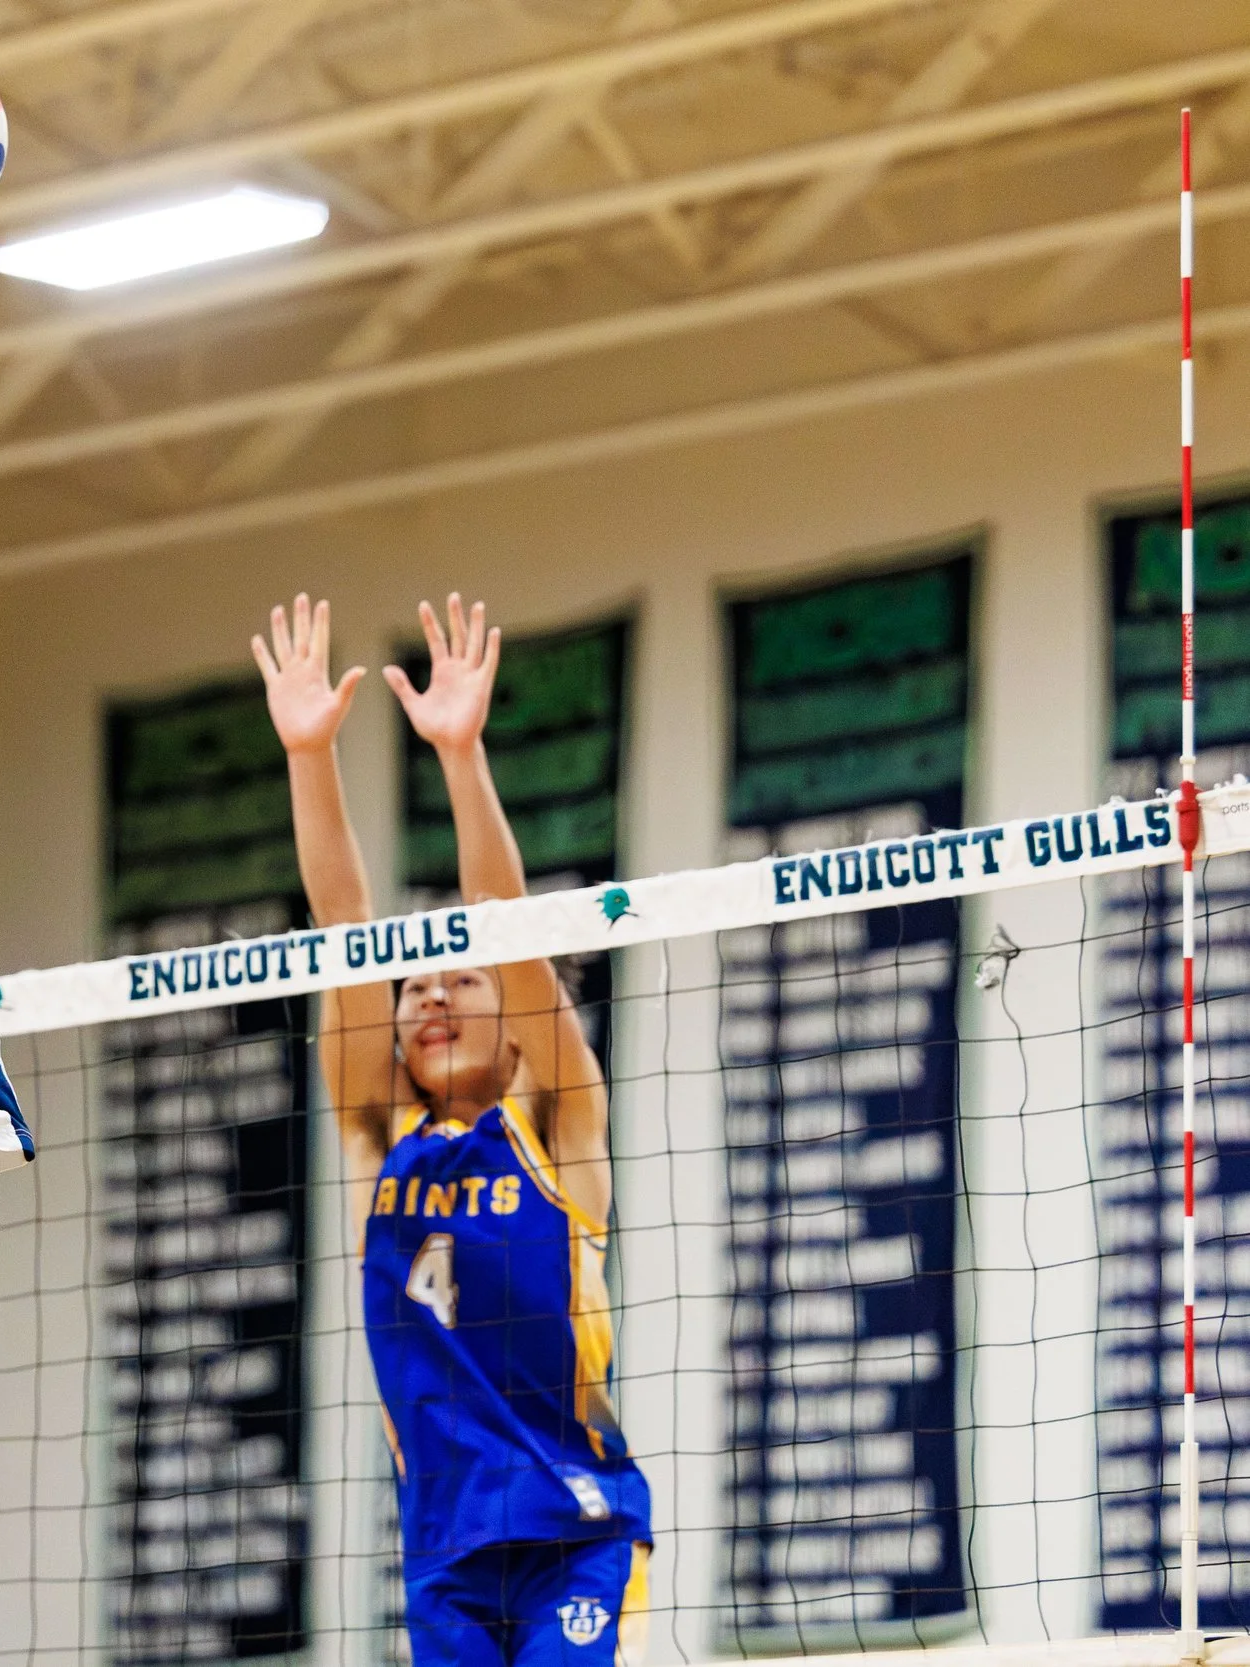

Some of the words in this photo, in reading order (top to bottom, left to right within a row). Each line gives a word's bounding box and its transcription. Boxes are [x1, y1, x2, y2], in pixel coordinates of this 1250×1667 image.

[772, 828, 1004, 905] ENDICOTT
[1025, 803, 1172, 867] GULLS
[128, 933, 326, 1001] ENDICOTT
[345, 911, 471, 969] GULLS
[374, 1174, 521, 1218] AINTS
[406, 1232, 459, 1329] 4
